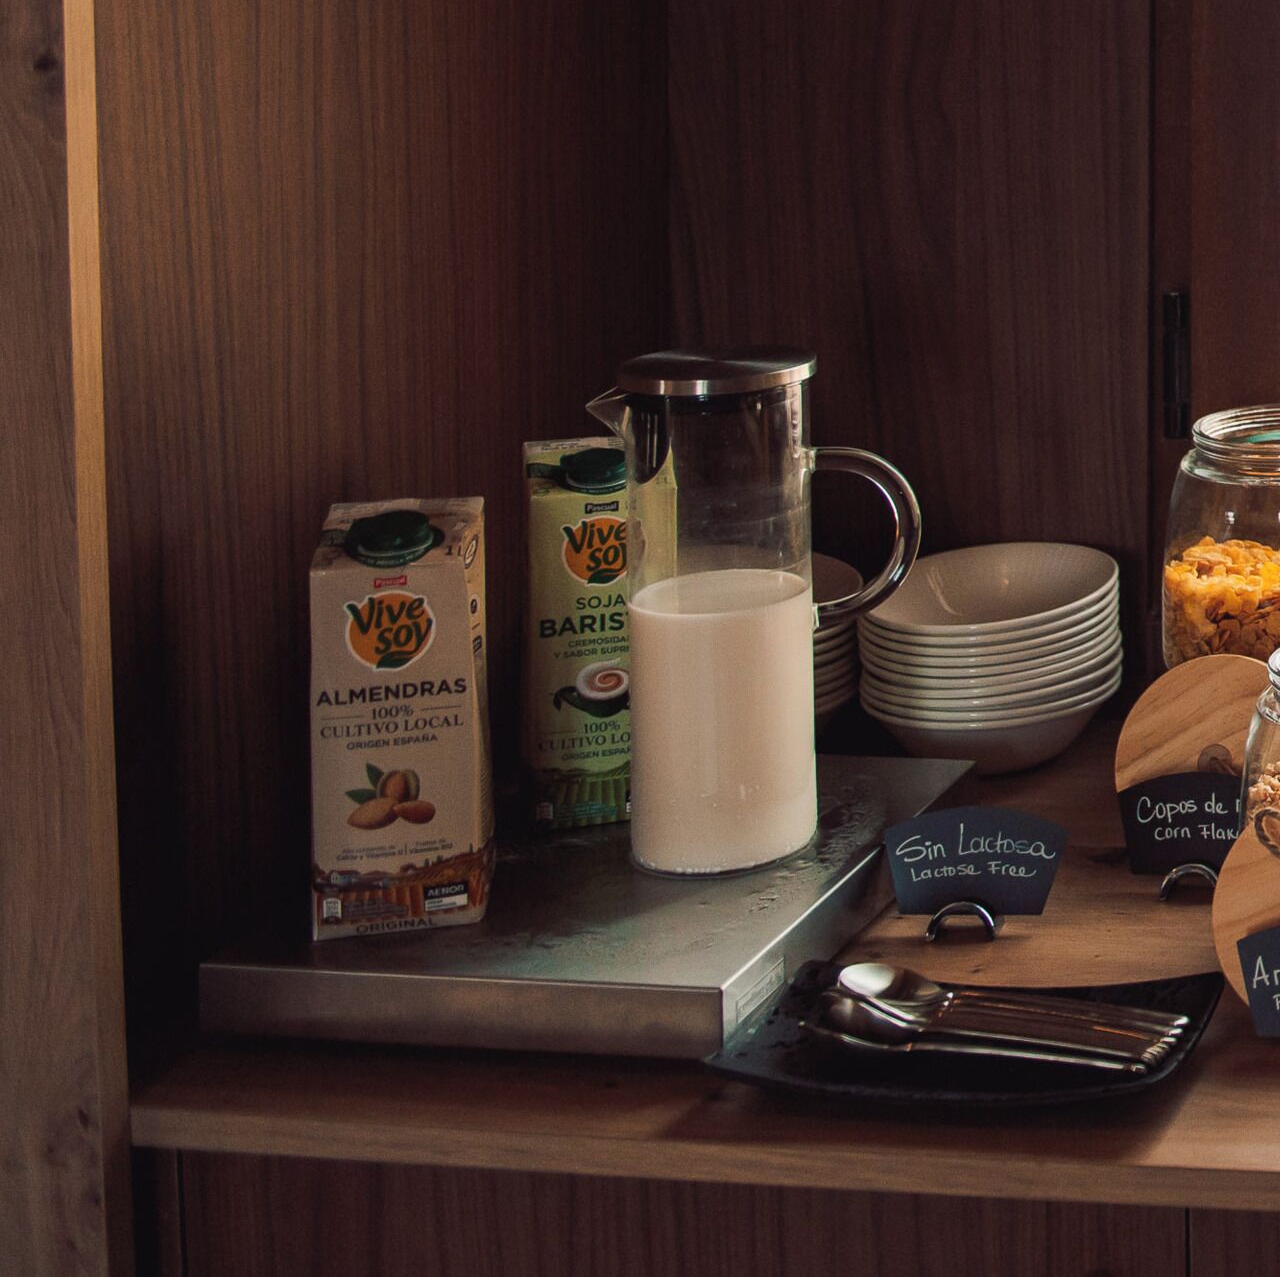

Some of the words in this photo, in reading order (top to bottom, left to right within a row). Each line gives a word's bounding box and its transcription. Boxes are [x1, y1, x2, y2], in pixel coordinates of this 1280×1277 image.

[562, 520, 627, 554] Vive
[576, 594, 627, 610] SOJA
[347, 596, 425, 635] Vive
[539, 611, 629, 638] BARIS
[374, 617, 434, 655] soy
[563, 648, 598, 659] SABOR
[600, 645, 630, 655] SUPR
[316, 678, 467, 706] ALMENDRAS
[371, 705, 414, 721] 100%
[320, 722, 399, 740] CULTIVO
[404, 714, 464, 732] LOCAL
[583, 720, 620, 734] 100%
[346, 737, 390, 751] ORIGEN
[393, 733, 438, 747] ESPAÑA
[539, 734, 607, 751] CULTIVO
[561, 751, 600, 761] ORIGEN
[1136, 796, 1198, 823] Copos
[1204, 792, 1229, 814] de
[896, 835, 946, 862] Sin
[958, 823, 1056, 859] Lactosa
[910, 863, 982, 882] Lactose
[987, 860, 1037, 878] Free
[356, 917, 438, 934] ORIGINAL
